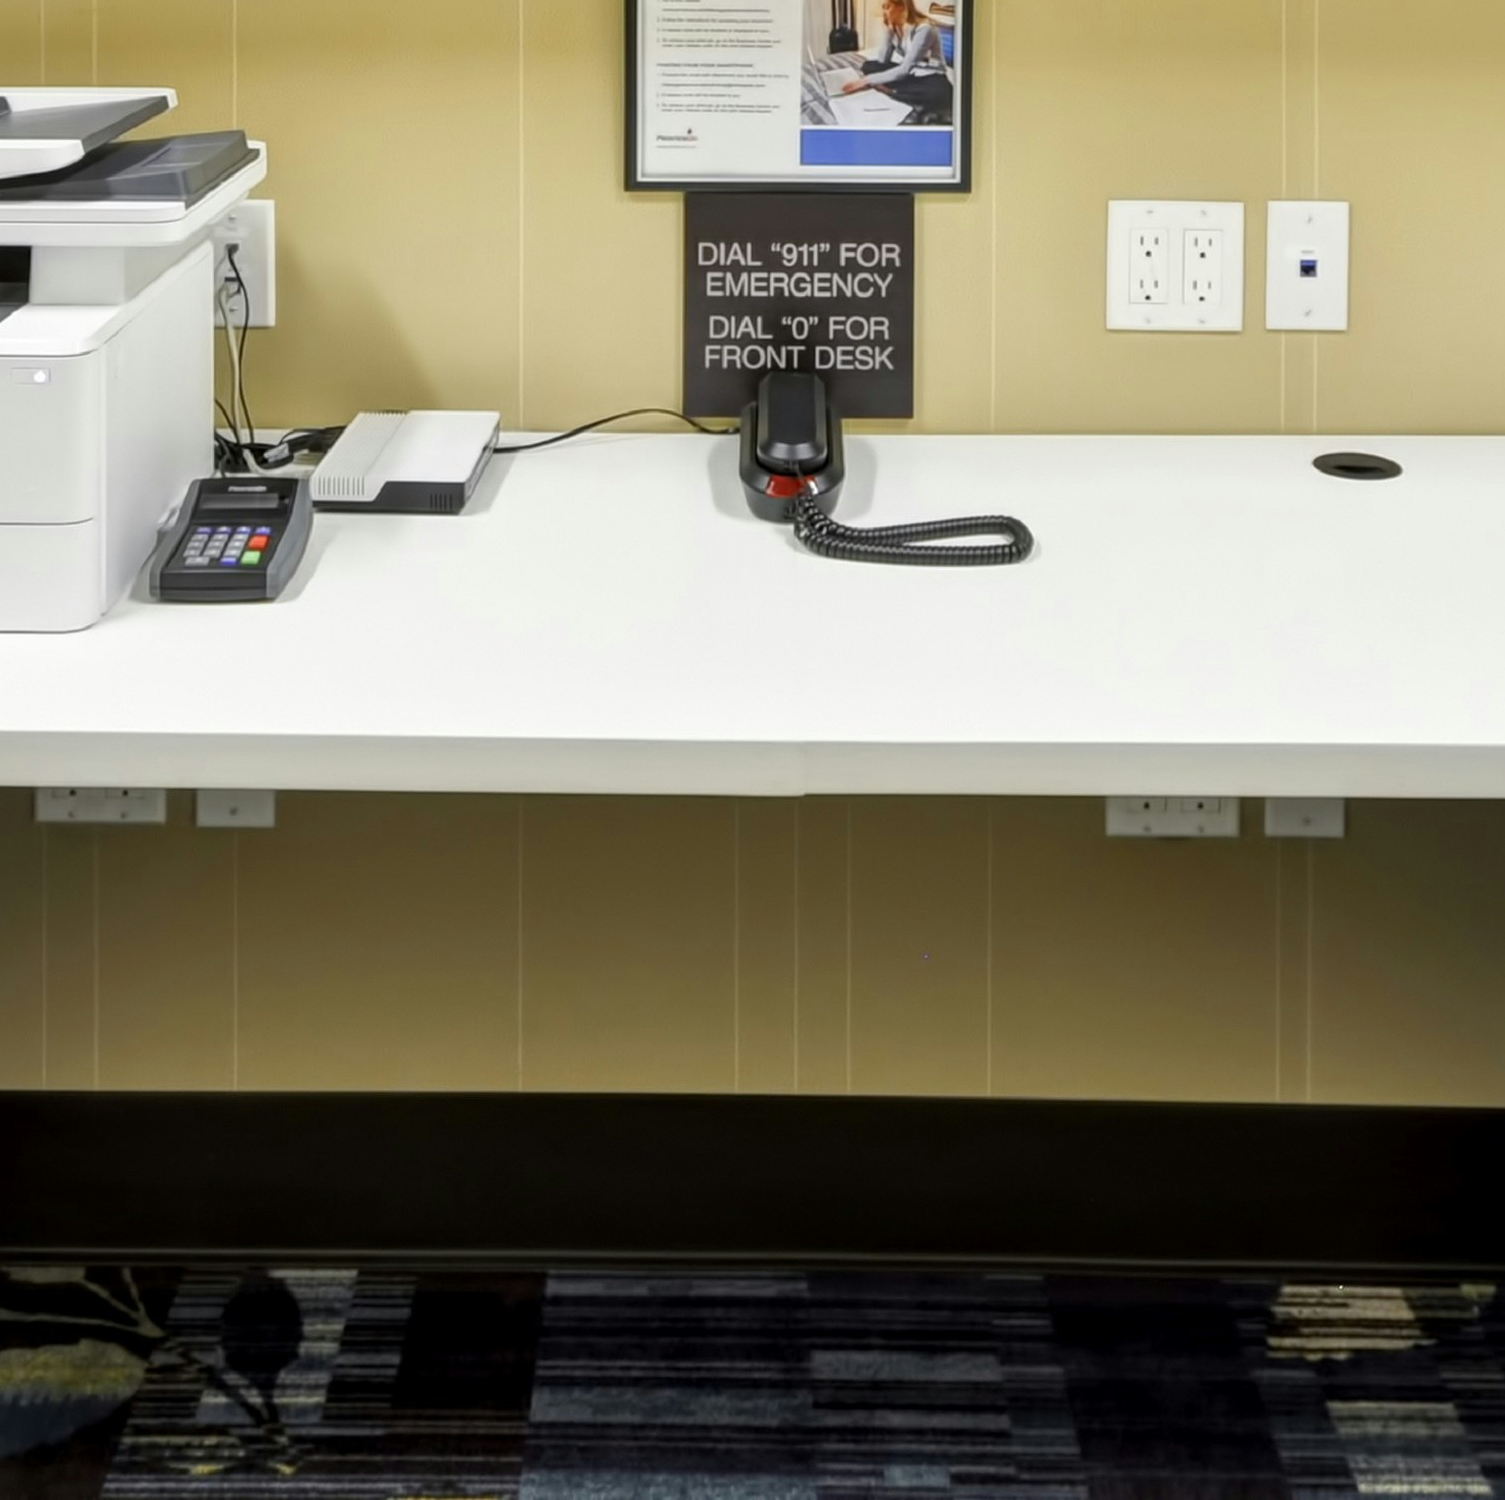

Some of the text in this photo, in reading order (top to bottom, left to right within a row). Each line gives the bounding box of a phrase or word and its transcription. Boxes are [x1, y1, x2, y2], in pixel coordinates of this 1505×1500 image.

[697, 242, 763, 266] DIAL
[839, 243, 901, 267] FOR
[706, 272, 893, 298] EMERGENCY
[708, 316, 773, 339] DIAL
[828, 316, 890, 340] FOR
[704, 345, 894, 370] FRONT DESK
